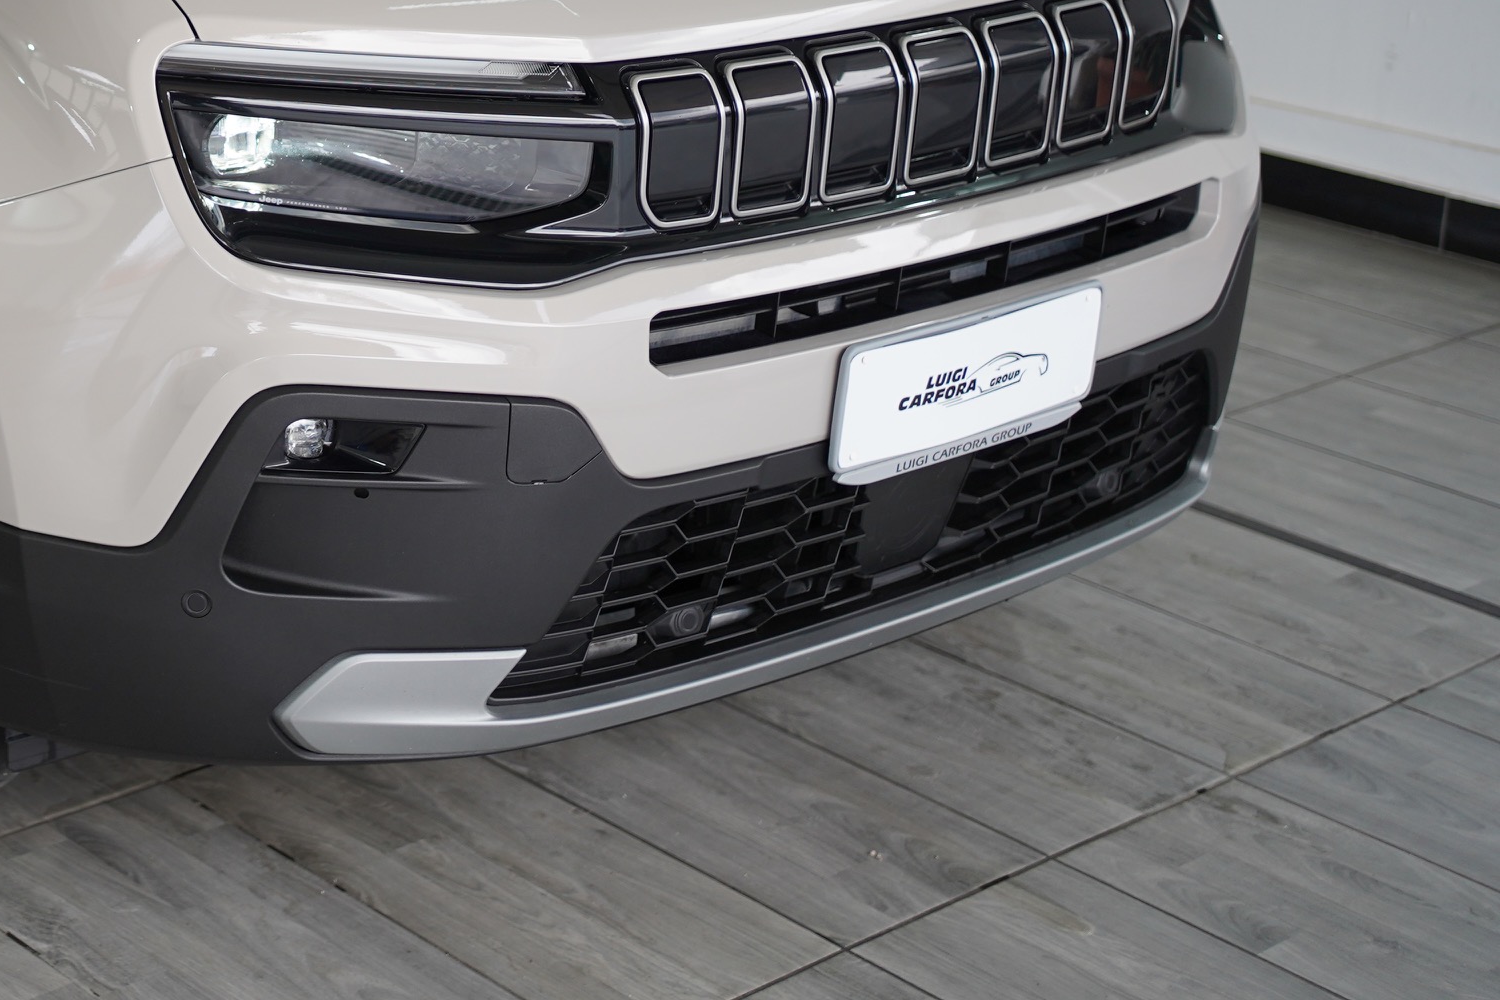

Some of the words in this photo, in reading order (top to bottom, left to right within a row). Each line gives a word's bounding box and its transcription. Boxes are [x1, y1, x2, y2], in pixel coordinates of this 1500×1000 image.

[258, 195, 283, 206] Jeep
[898, 378, 977, 411] CARFORA
[989, 369, 1020, 387] GROUP
[925, 366, 968, 390] LUIGI
[896, 455, 928, 473] LUIGI
[932, 437, 988, 463] CARFORA
[991, 422, 1032, 443] GROUP
